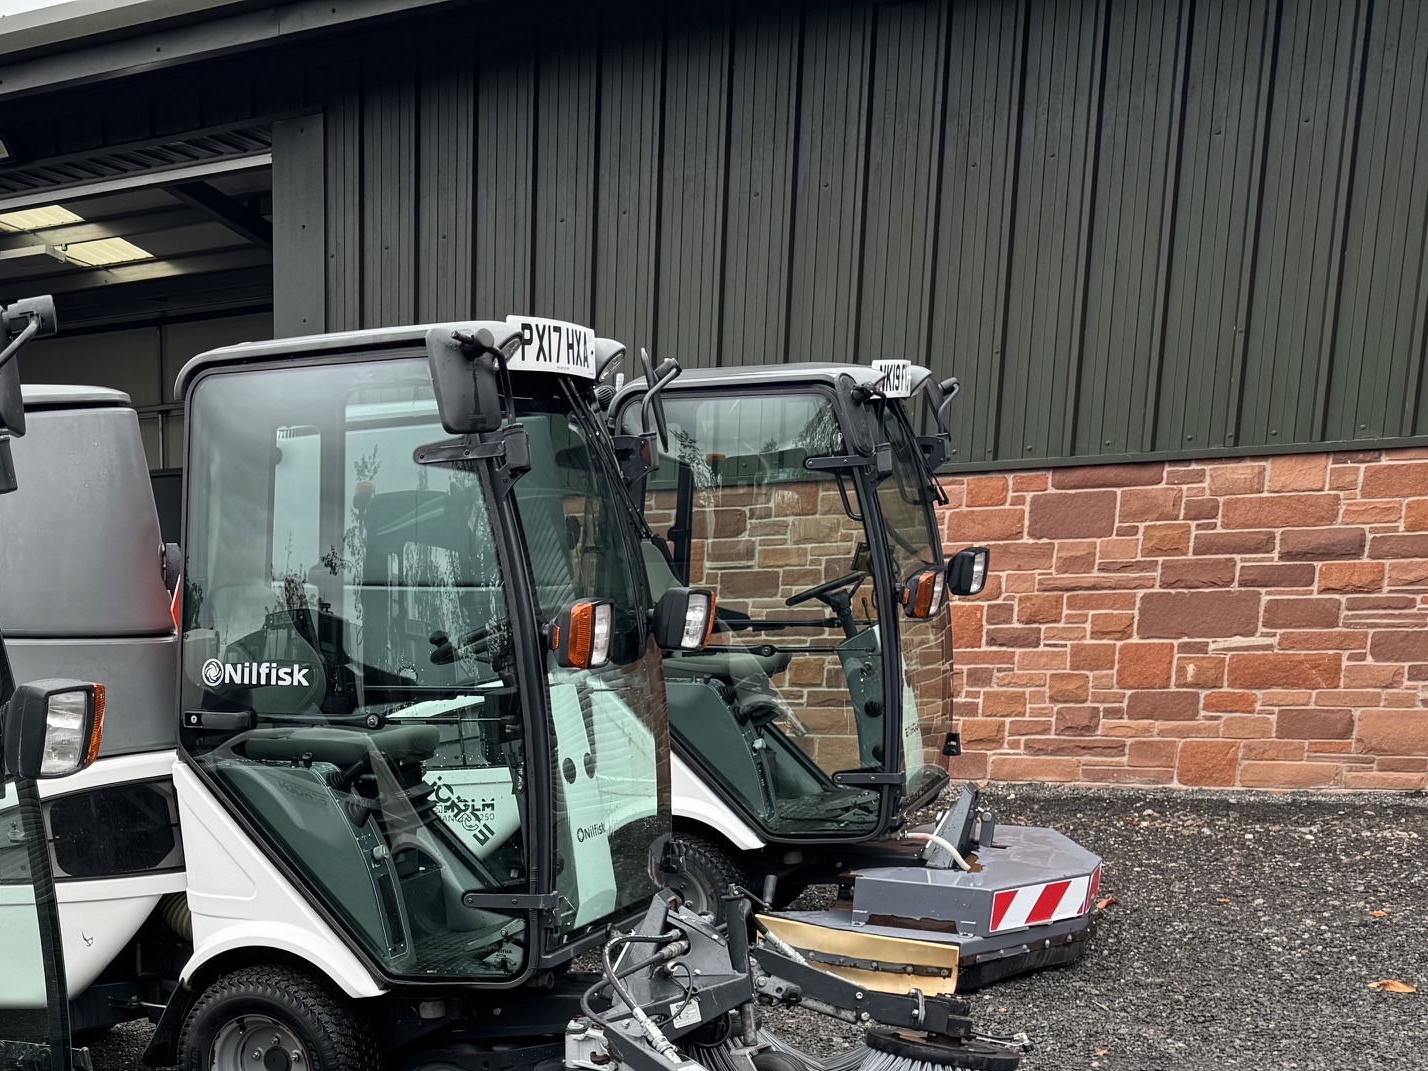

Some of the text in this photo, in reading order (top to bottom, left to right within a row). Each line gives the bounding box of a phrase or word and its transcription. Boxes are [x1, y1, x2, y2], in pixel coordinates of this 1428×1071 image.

[521, 323, 590, 368] PX17 HXA
[224, 662, 310, 686] Nilfisk
[584, 822, 606, 839] Nilfisk
